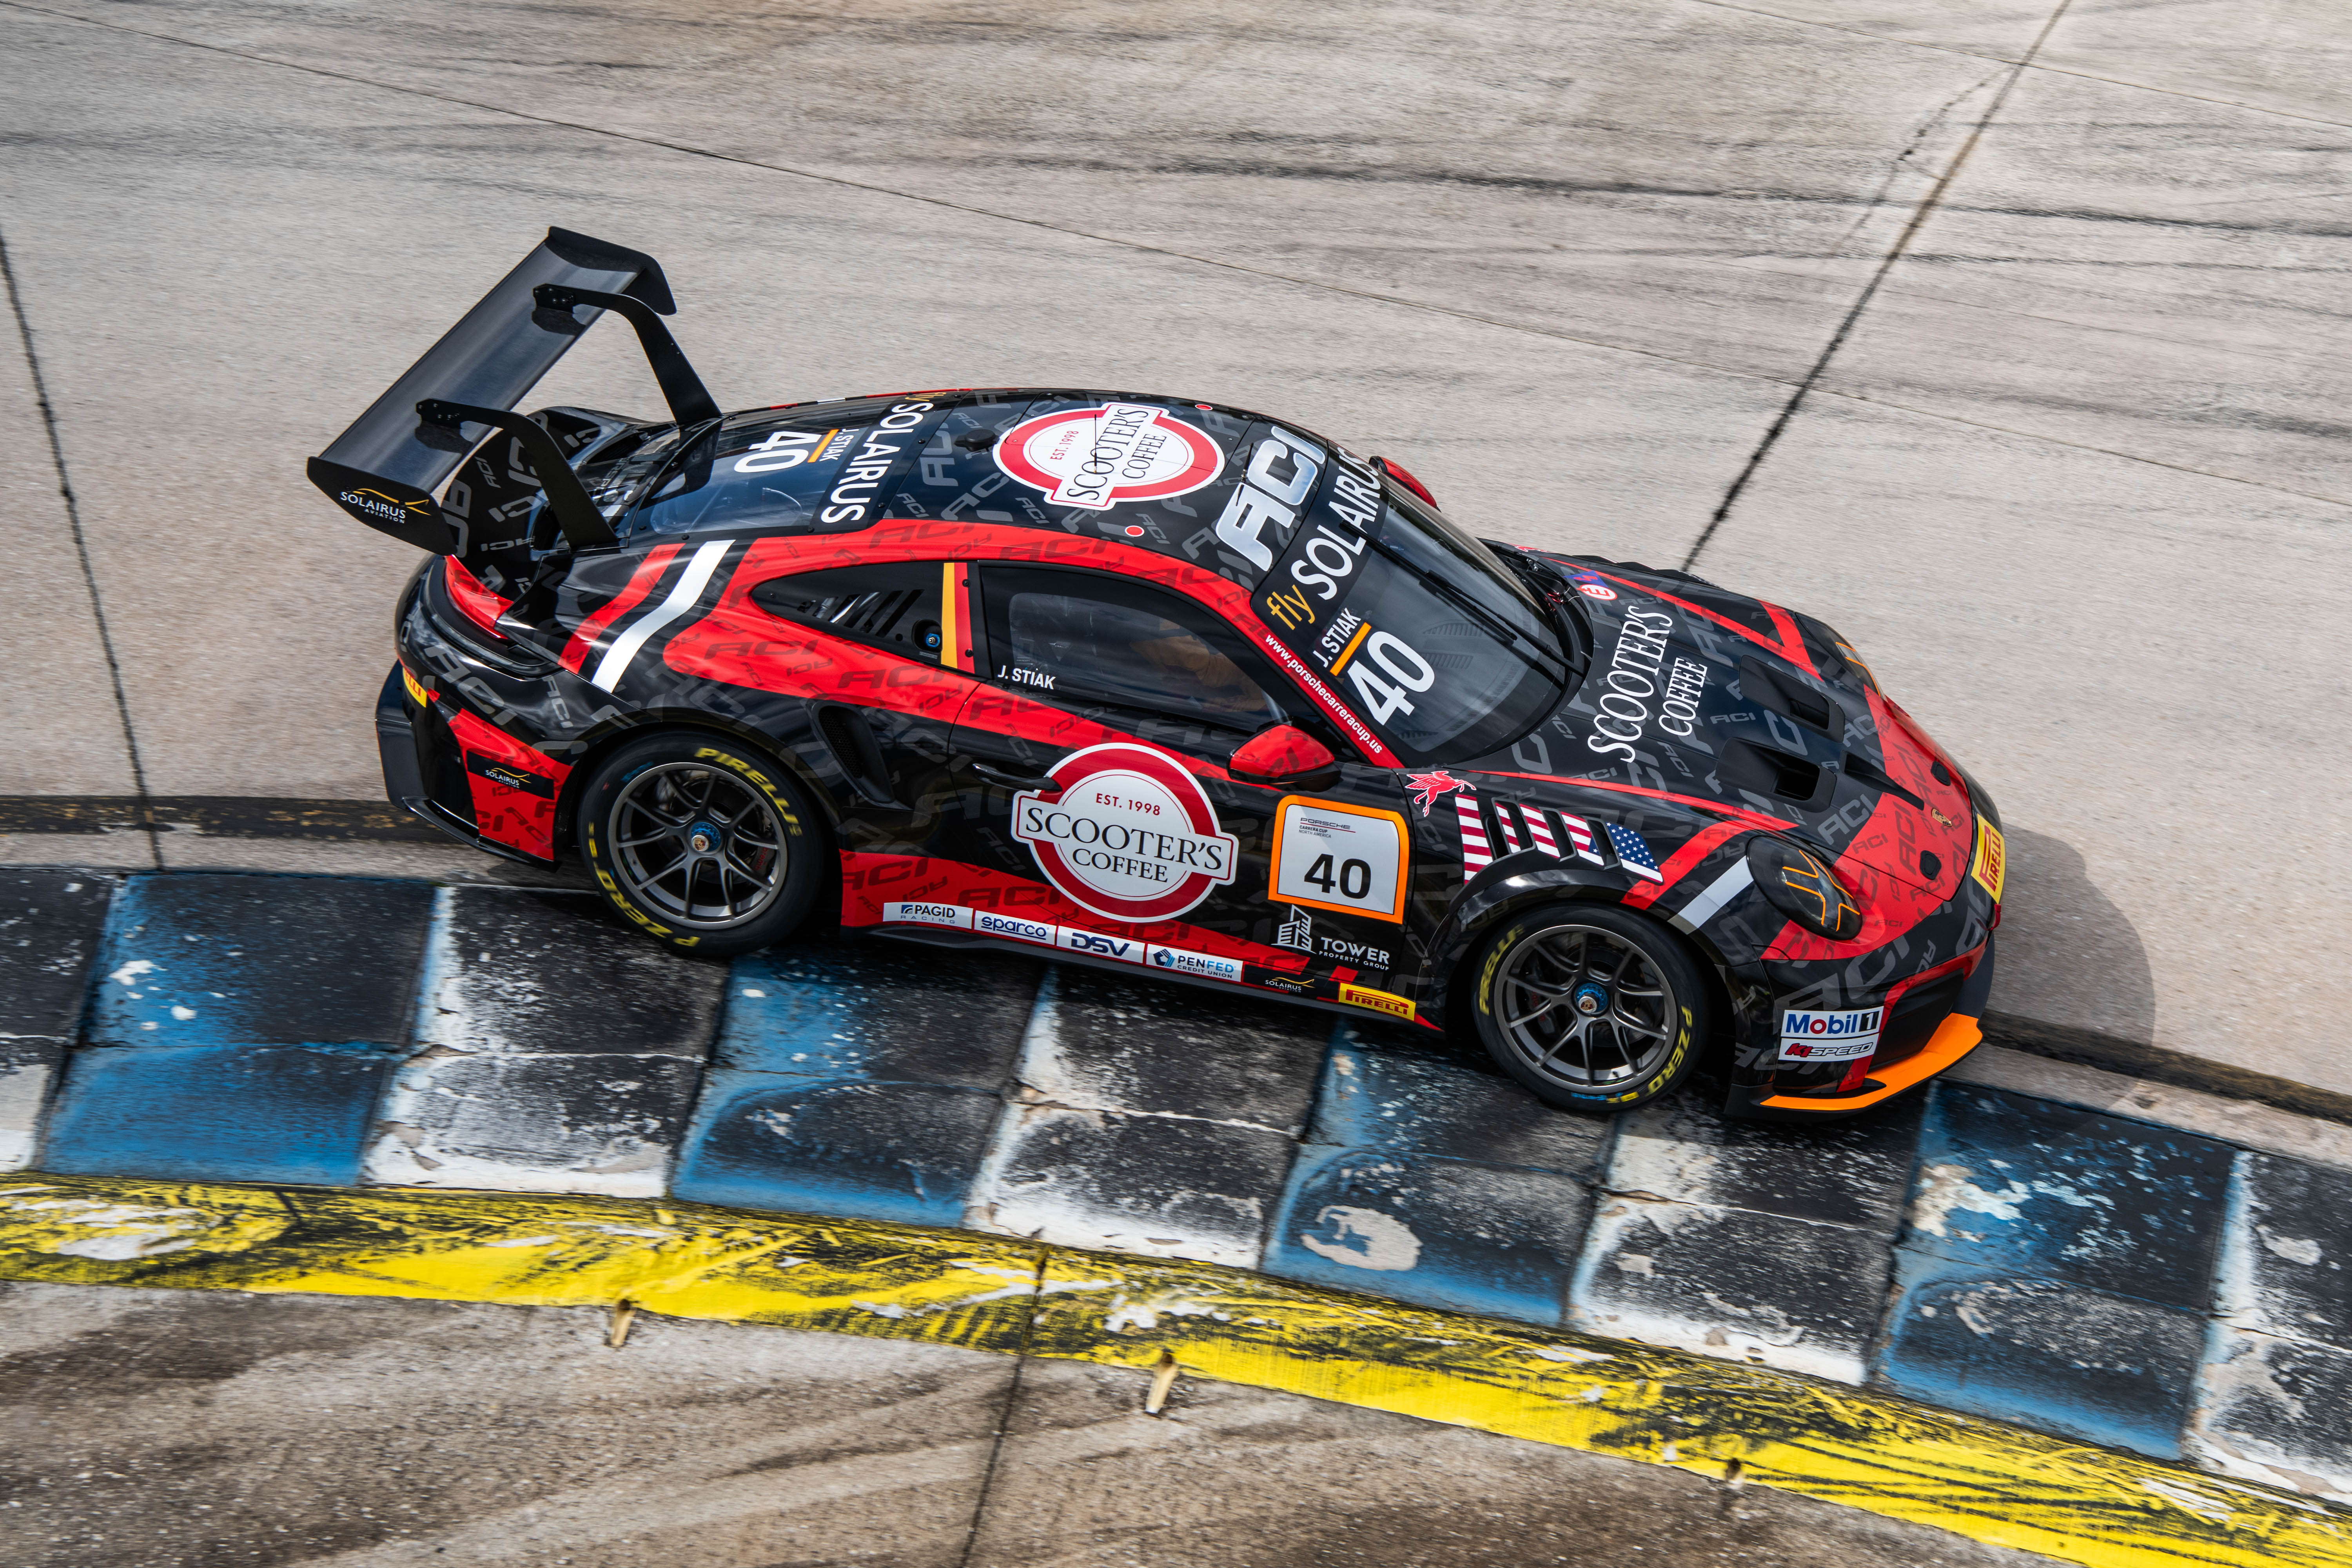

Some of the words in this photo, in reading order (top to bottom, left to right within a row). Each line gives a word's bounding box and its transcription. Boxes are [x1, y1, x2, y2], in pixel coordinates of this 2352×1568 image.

[819, 435, 854, 462] STIAK
[1059, 431, 1079, 445] 1998
[734, 431, 822, 473] 40
[821, 403, 934, 523] SOLAIRUS
[1050, 447, 1069, 460] EST.
[1067, 409, 1148, 500] SCOOTER'S
[1122, 434, 1167, 479] COFFEE
[340, 492, 406, 519] SOLAIRUS
[897, 493, 930, 518] ACI
[1015, 497, 1050, 524] ACI
[1216, 425, 1326, 572] ACI
[365, 509, 405, 524] AVIATION
[1135, 513, 1171, 544] ACI
[1267, 584, 1316, 631] fly
[1292, 447, 1381, 600] SOLAIRUS
[1321, 608, 1361, 653] STIAK
[704, 639, 819, 660] ACI
[1312, 650, 1332, 668] J.
[424, 644, 517, 725] ACI
[838, 666, 946, 689] ACI
[998, 665, 1009, 679] J.
[1012, 668, 1056, 690] STIAK
[1347, 630, 1435, 726] 40
[1587, 606, 1673, 763] SCOOTER'S
[1265, 635, 1383, 753] www.porschecarreracup.us
[1658, 657, 1708, 736] COFFEE
[1710, 712, 1756, 725] ACI
[1658, 741, 1694, 777] ACI
[485, 770, 519, 786] SOLAIRUS
[694, 748, 800, 826] PIRELLI
[1095, 793, 1122, 808] EST.
[1128, 800, 1161, 816] 1998
[1301, 818, 1350, 829] PORSCHE
[1026, 808, 1222, 870] SCOOTER'S
[1852, 833, 1889, 855] ACI
[1893, 801, 1917, 876] ACI
[1073, 848, 1169, 883] COFFEE
[1979, 825, 2001, 892] PIRELLI
[903, 877, 948, 901] ACI
[1304, 853, 1371, 899] 40
[595, 869, 673, 938] ZERO
[915, 905, 956, 918] PAGID
[900, 915, 955, 924] RACING
[981, 916, 1046, 938] sparco
[1071, 932, 1131, 956] DSV
[1321, 936, 1390, 964] TOWER
[1177, 965, 1205, 974] CREDIT
[1207, 970, 1232, 979] UNION
[1178, 955, 1234, 973] PENFED
[1319, 951, 1359, 963] PROPERTY
[1363, 960, 1390, 971] GROUP
[1265, 980, 1301, 991] SOLAIRUS
[1345, 989, 1409, 1015] PIRELLI
[1786, 1014, 1858, 1034] Mobil
[1647, 1027, 1691, 1096] ZERO
